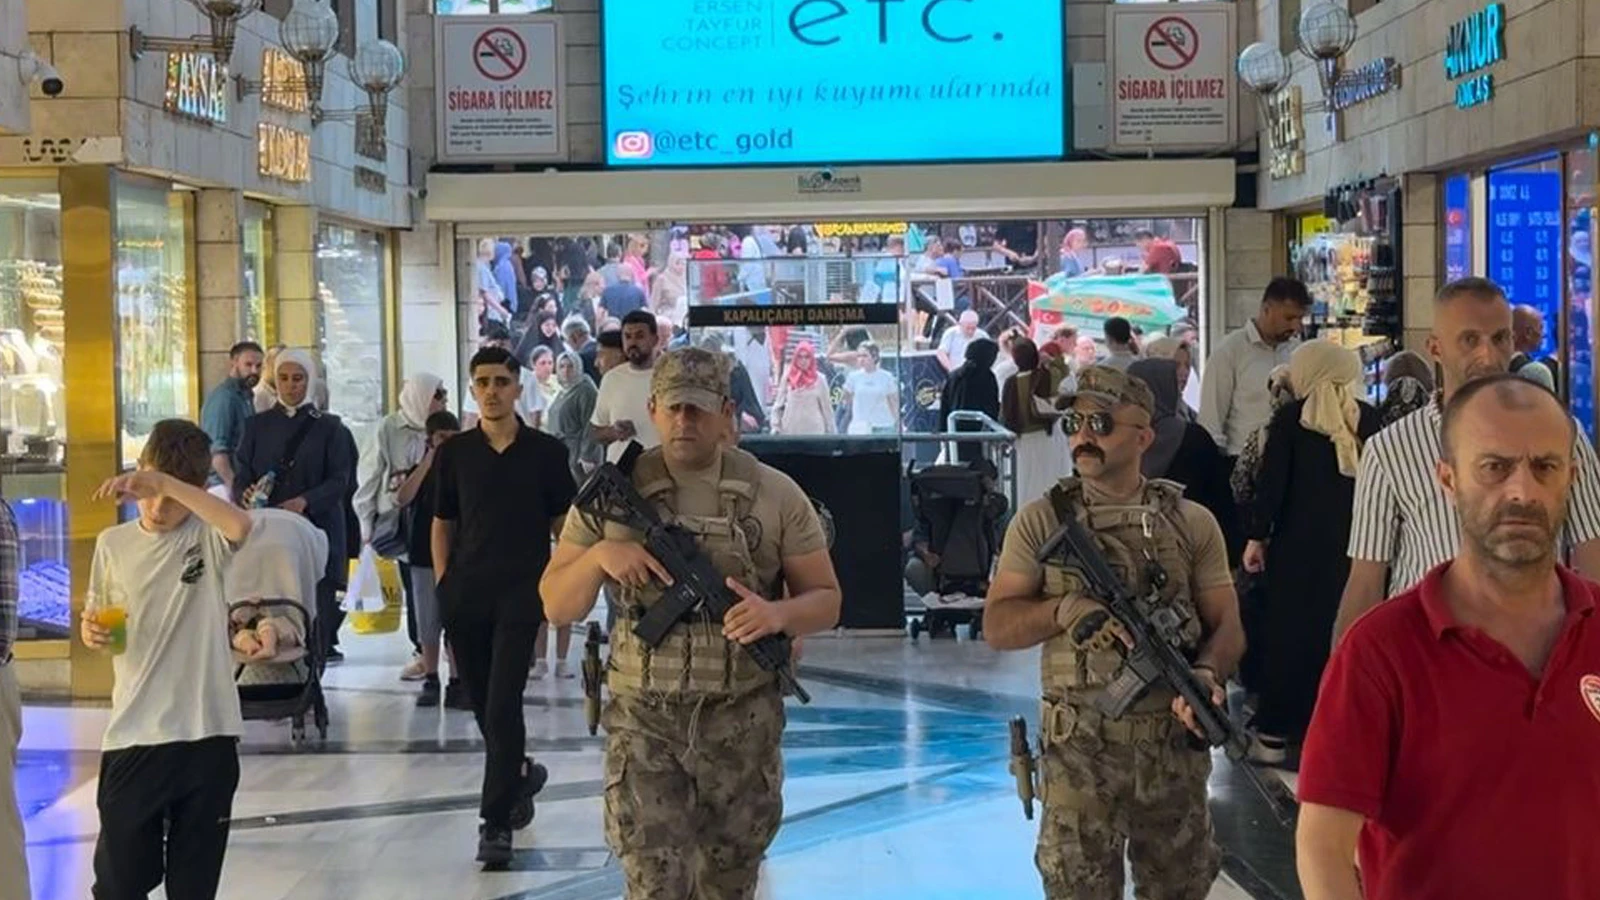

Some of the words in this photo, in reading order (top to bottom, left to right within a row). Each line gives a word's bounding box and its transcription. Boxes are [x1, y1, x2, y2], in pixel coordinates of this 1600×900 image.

[685, 18, 762, 32] TAYFUR
[661, 36, 762, 51] CONCEPT
[448, 85, 497, 111] SİGARA
[499, 84, 553, 115] İÇİLMEZ
[722, 84, 755, 104] en
[1119, 75, 1167, 100] SİGARA
[1170, 74, 1225, 105] İÇİLMEZ
[654, 128, 793, 155] @etc_gold
[723, 308, 804, 324] KAPALIÇARŞI
[807, 307, 865, 324] DANIŞMA
